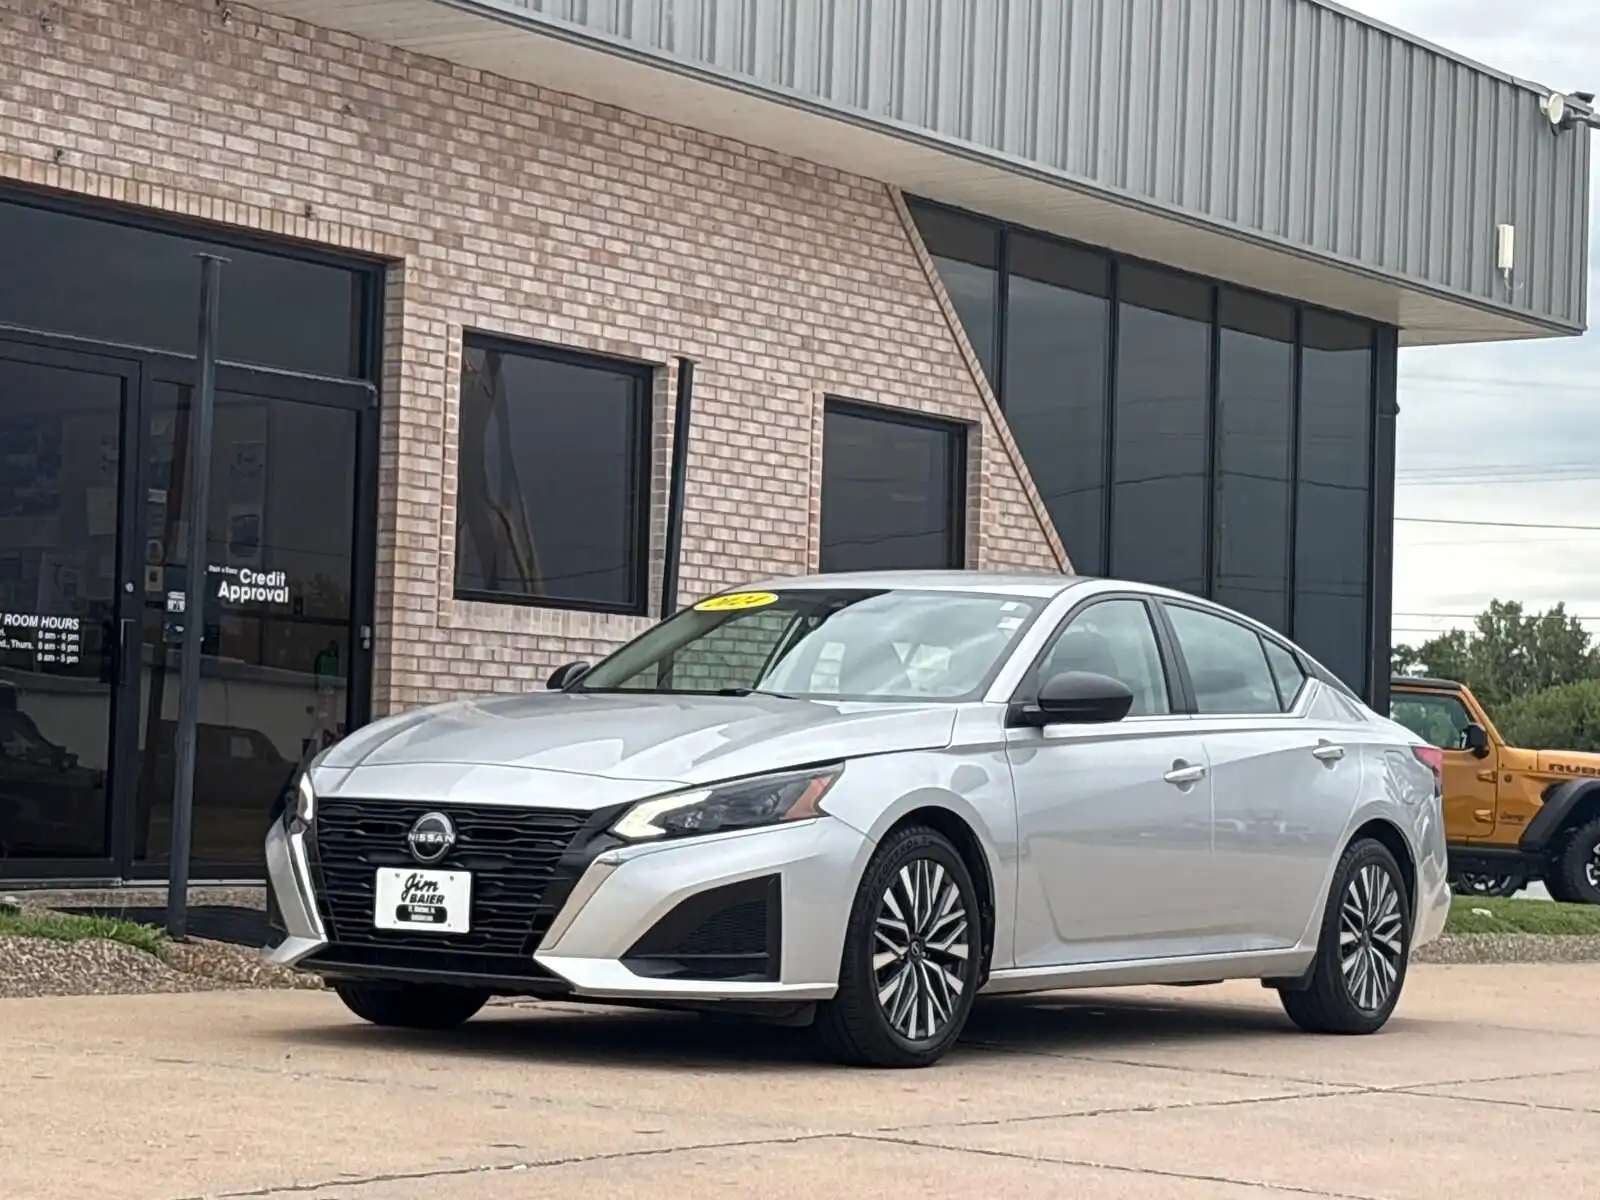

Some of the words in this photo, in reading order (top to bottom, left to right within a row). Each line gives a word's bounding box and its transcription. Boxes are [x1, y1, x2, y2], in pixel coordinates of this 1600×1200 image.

[240, 568, 286, 587] Credit
[218, 580, 289, 603] Approval
[4, 613, 38, 627] ROOM
[40, 616, 79, 630] HOURS
[10, 639, 35, 650] Thurs.
[408, 832, 455, 843] NISSAN
[401, 872, 439, 902] Jim
[409, 893, 445, 904] BAIER
